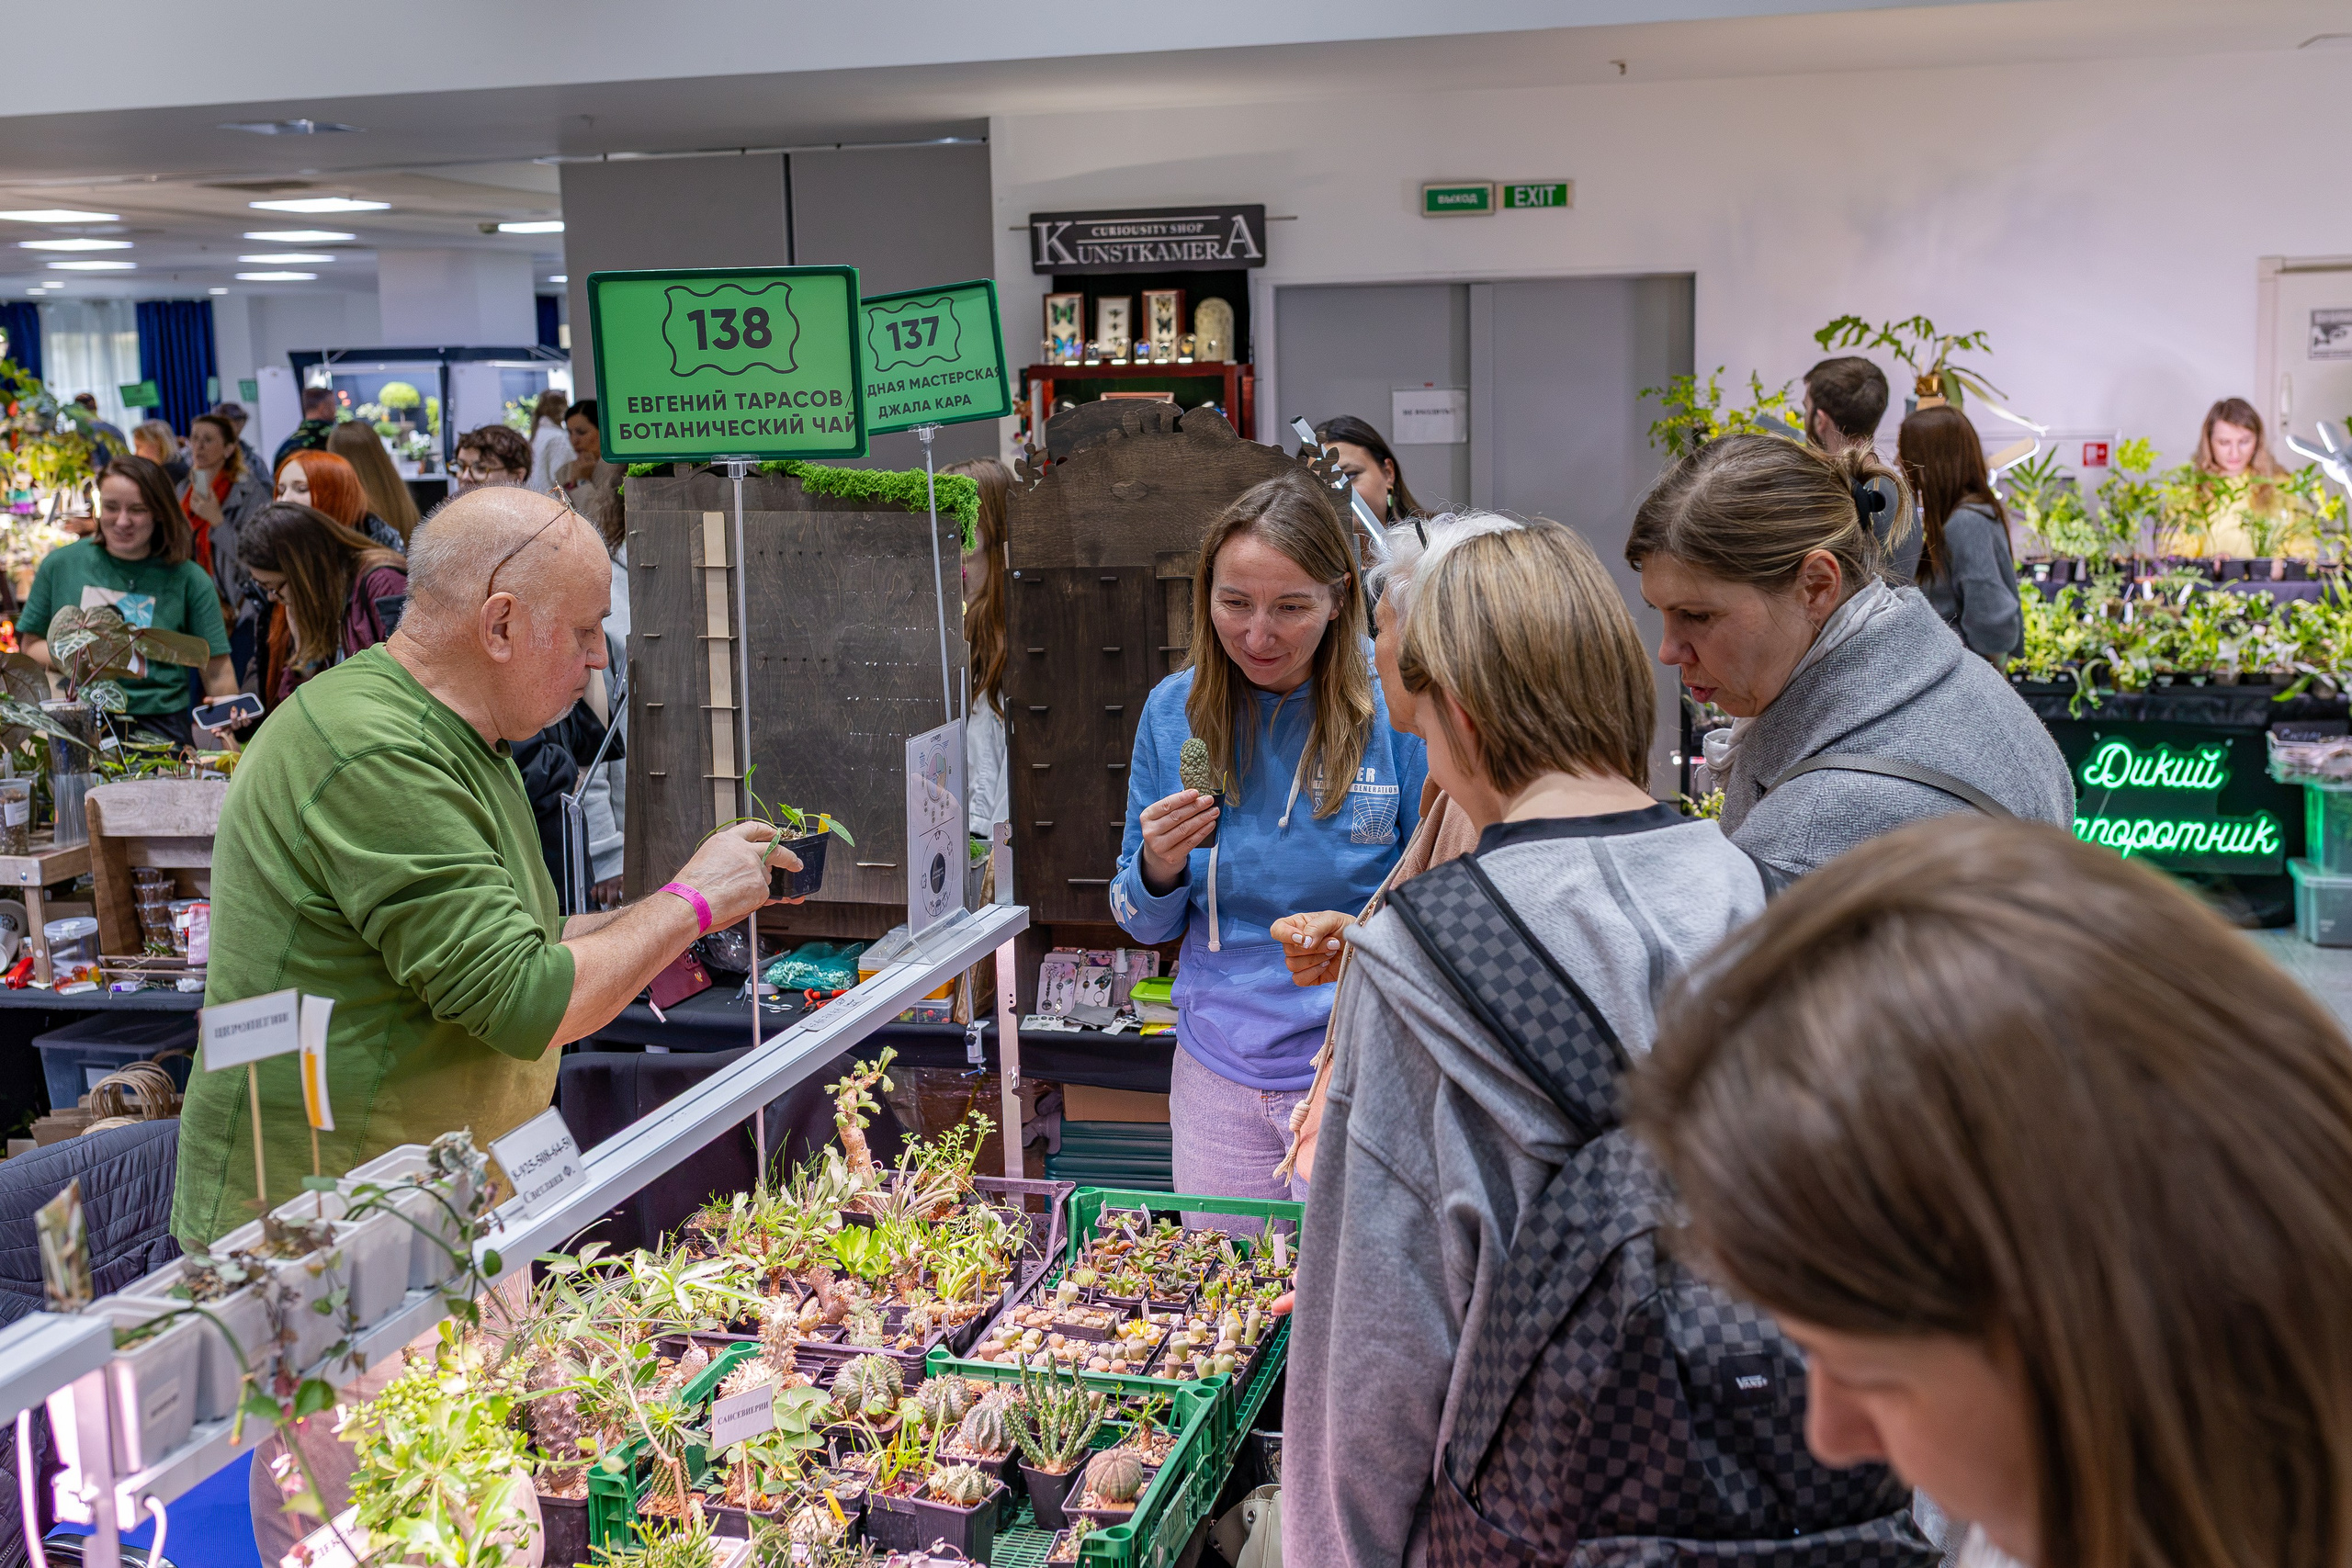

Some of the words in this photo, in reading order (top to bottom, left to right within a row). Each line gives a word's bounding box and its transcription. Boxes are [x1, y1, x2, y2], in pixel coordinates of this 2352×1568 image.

[1437, 193, 1478, 205] ВЫХОД
[1514, 186, 1556, 206] EXIT
[1033, 214, 1262, 265] KUNSTKAMERA
[1091, 224, 1168, 237] CURIOUSITY
[1170, 222, 1204, 234] SHOP
[686, 306, 773, 351] 138
[885, 315, 940, 351] 137
[628, 389, 727, 413] ЕВГЕНИЙ
[865, 379, 905, 398] ДНАЯ
[878, 399, 932, 420] ДЖАЛА
[934, 393, 972, 410] КАРА
[619, 413, 804, 440] БОТАНИЧЕСКИЙ
[812, 412, 855, 434] ЧАЙ
[2083, 742, 2224, 790] Дикий
[1353, 784, 1397, 795] GENERATION
[2073, 815, 2281, 860] апоротник
[718, 1401, 769, 1425] САНСЕВИЕРИИ
